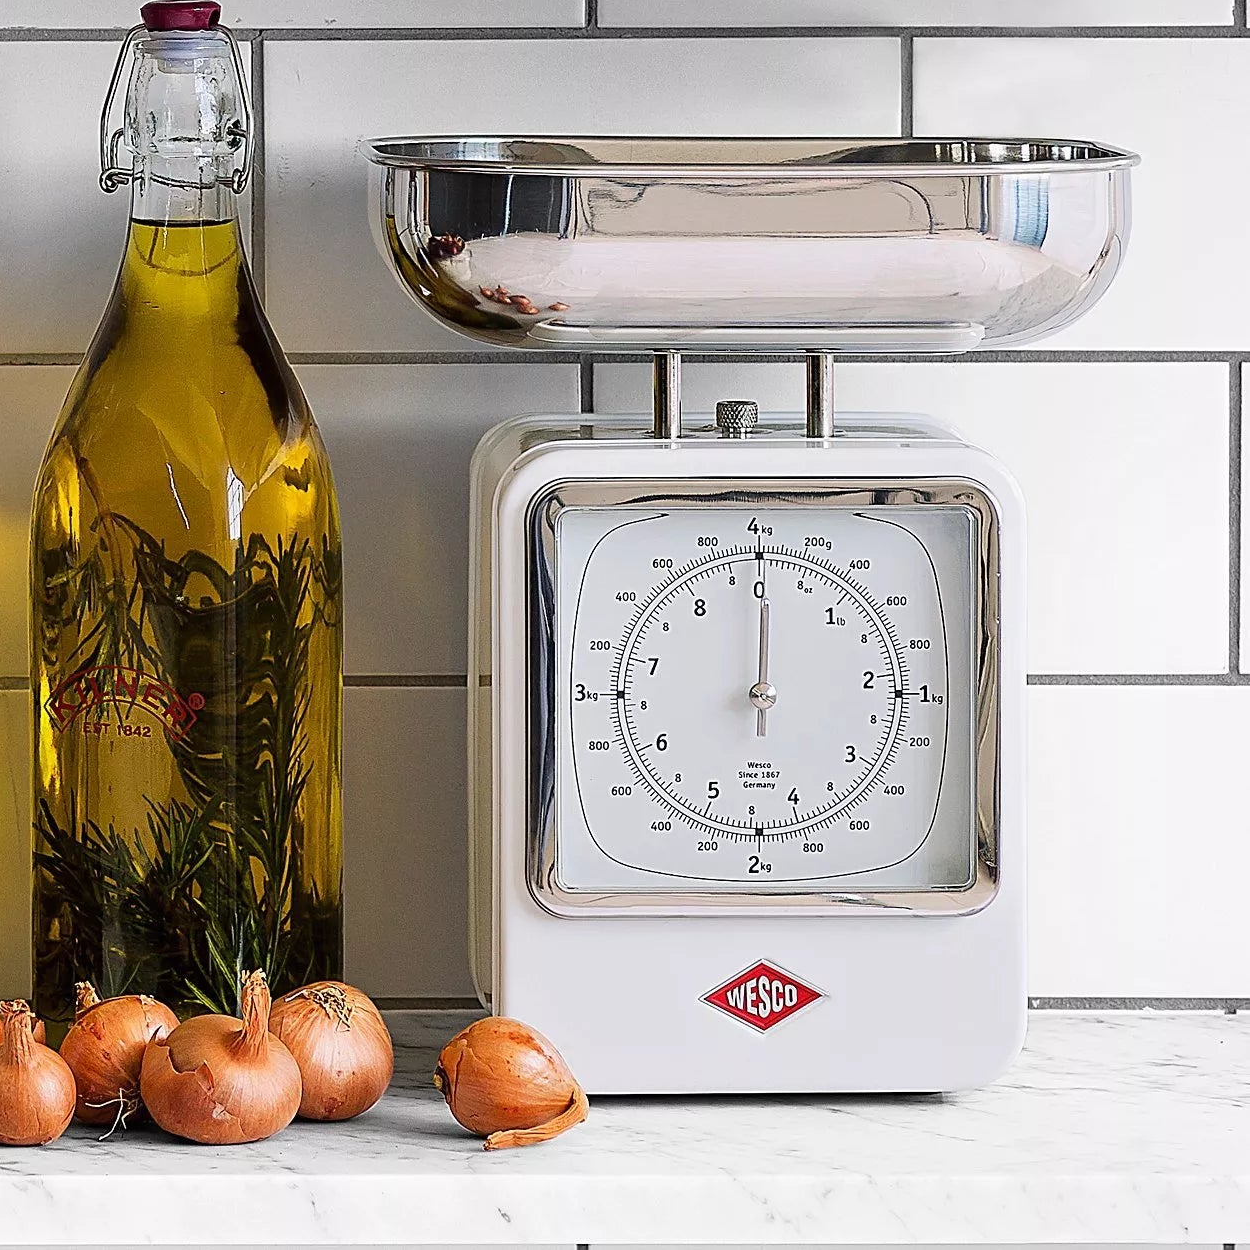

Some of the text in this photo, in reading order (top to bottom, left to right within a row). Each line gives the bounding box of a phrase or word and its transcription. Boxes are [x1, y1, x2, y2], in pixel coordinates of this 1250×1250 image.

[697, 536, 719, 549] 800
[652, 558, 674, 569] 600
[848, 559, 871, 571] 400
[728, 575, 736, 586] 8
[754, 582, 765, 599] 0
[615, 591, 637, 602] 400
[886, 595, 907, 607] 600
[693, 598, 707, 617] 8
[662, 621, 670, 632] 8
[860, 633, 868, 644] 8
[589, 640, 611, 651] 200
[909, 639, 931, 650] 800
[647, 657, 659, 676] 7
[863, 670, 875, 690] 2
[49, 675, 187, 729] KILNER
[640, 700, 648, 711] 8
[870, 714, 878, 725] 8
[83, 722, 151, 738] EST 1842
[588, 740, 610, 751] 800
[656, 733, 668, 751] 6
[909, 736, 930, 747] 200
[844, 745, 856, 763] 3
[748, 761, 772, 769] Wesco
[674, 773, 682, 783] 8
[611, 785, 632, 796] 600
[707, 781, 720, 800] 5
[743, 781, 775, 789] Germany
[826, 781, 834, 792] 8
[882, 782, 905, 796] 400
[788, 788, 799, 805] 4
[748, 805, 756, 816] 8
[650, 821, 672, 832] 400
[849, 820, 870, 831] 600
[697, 839, 719, 852] 200
[802, 839, 824, 853] 800
[726, 975, 798, 1018] WESCO
